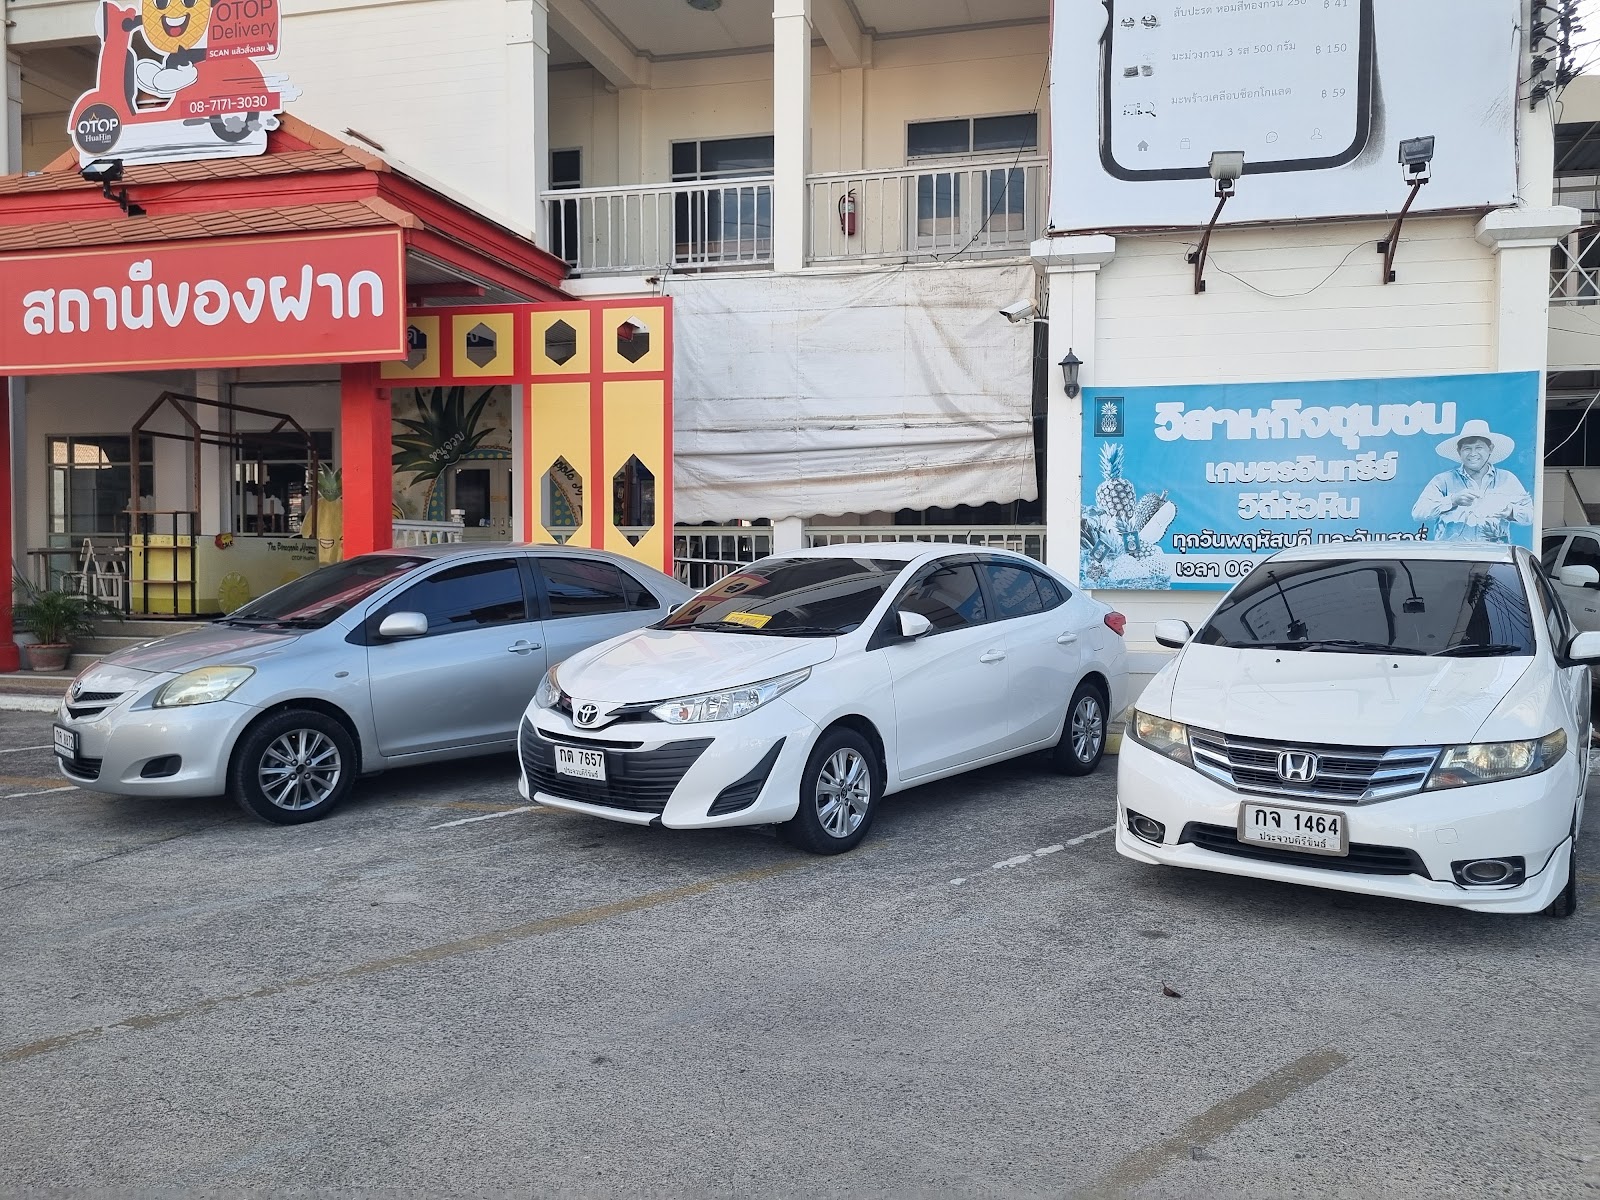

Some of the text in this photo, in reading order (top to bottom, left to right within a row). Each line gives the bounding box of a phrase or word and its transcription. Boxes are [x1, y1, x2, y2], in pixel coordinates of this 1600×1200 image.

[216, 0, 273, 22] OTOP
[1334, 0, 1348, 8] 41
[212, 22, 276, 40] Delivery
[209, 50, 230, 58] SCAN
[1227, 48, 1234, 56] 3
[1254, 44, 1273, 54] 500
[1276, 40, 1297, 52] กรัม
[1326, 43, 1347, 54] 150
[1332, 88, 1346, 98] 59
[189, 95, 268, 114] 08-7171-3030
[78, 118, 119, 134] OTOP
[22, 258, 384, 336] สถานีของฝาก
[1153, 399, 1457, 450] วิสาหกิจชุมชน
[1205, 451, 1399, 483] เกษตรอินทรีย์
[1172, 528, 1313, 554] ทุกวันพฤหัสบดี
[1175, 560, 1220, 577] เวลา
[578, 751, 603, 768] 7657
[1255, 809, 1339, 835] กจ 1464
[1259, 831, 1327, 848] ประจวบคีรีขันธ์
